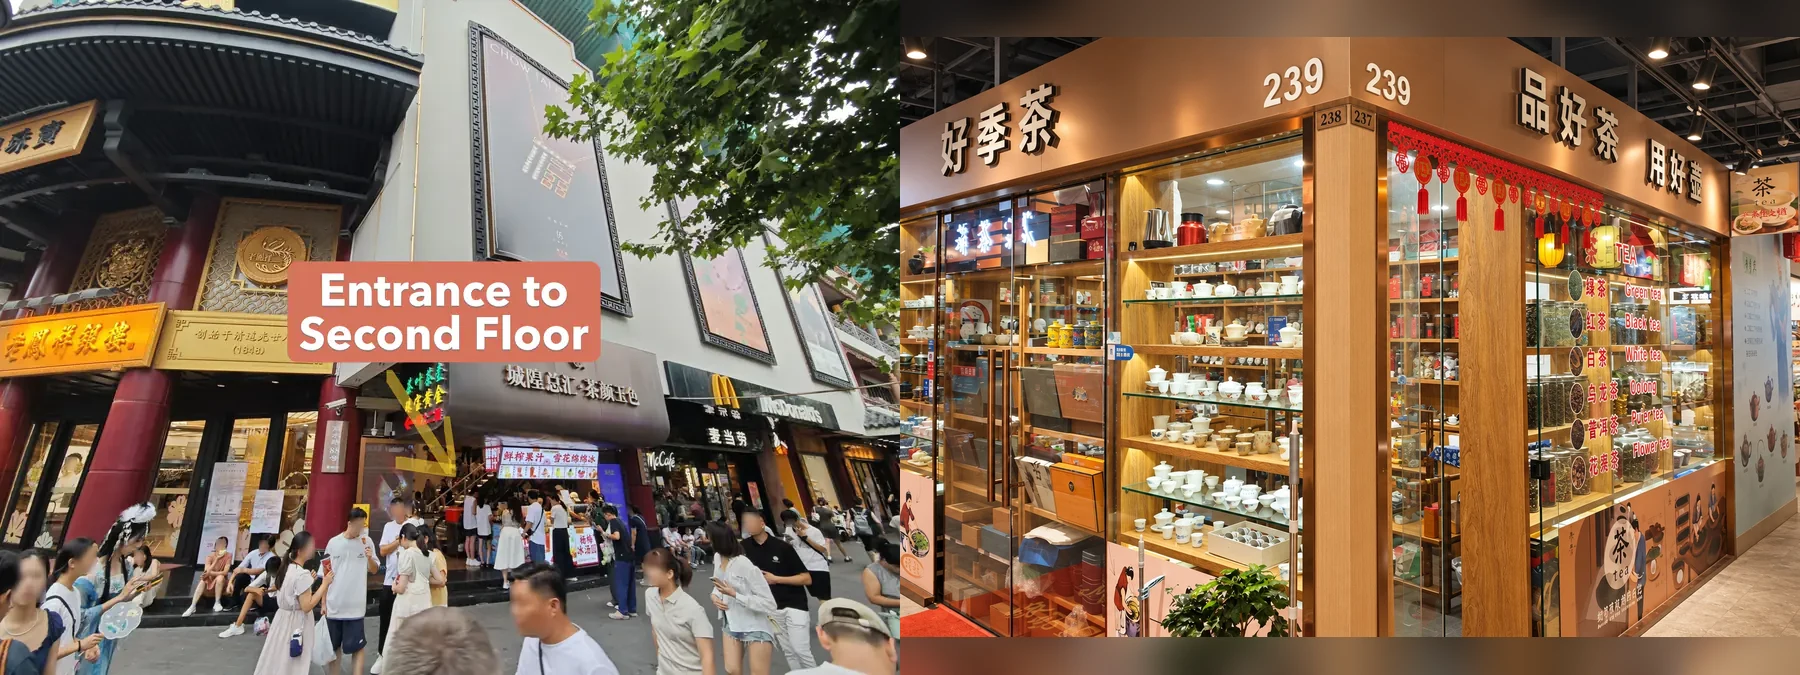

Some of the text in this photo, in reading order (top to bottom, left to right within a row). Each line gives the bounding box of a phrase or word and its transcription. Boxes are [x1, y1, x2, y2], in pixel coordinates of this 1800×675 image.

[490, 43, 530, 73] CHOW
[1263, 57, 1324, 108] 239
[1366, 62, 1411, 106] 239
[1320, 110, 1342, 127] 238
[1354, 110, 1373, 127] 237
[1517, 67, 1620, 163] 品好茶
[0, 120, 66, 154] 珠寶
[941, 83, 1056, 177] 好季茶
[1752, 176, 1776, 197] 茶
[1616, 243, 1637, 267] TEA
[1585, 276, 1606, 298] 绿茶
[1625, 282, 1648, 299] Green
[1650, 286, 1662, 301] tea
[1586, 311, 1661, 332] 红茶 Black tea
[1587, 345, 1662, 368] 白茶 White tea
[1587, 379, 1657, 404] 乌龙茶 Oolong
[760, 395, 823, 424] McDonald's
[1588, 414, 1618, 440] 普洱茶
[1652, 407, 1664, 421] tea
[708, 427, 747, 447] 麦当劳
[1633, 440, 1658, 458] Flower
[1659, 437, 1670, 451] tea
[503, 451, 544, 462] 鲜榨果汁
[553, 453, 596, 463] 雪花绵绵冰
[646, 451, 675, 471] McCafé
[1613, 526, 1629, 564] 茶
[1613, 566, 1629, 581] tea
